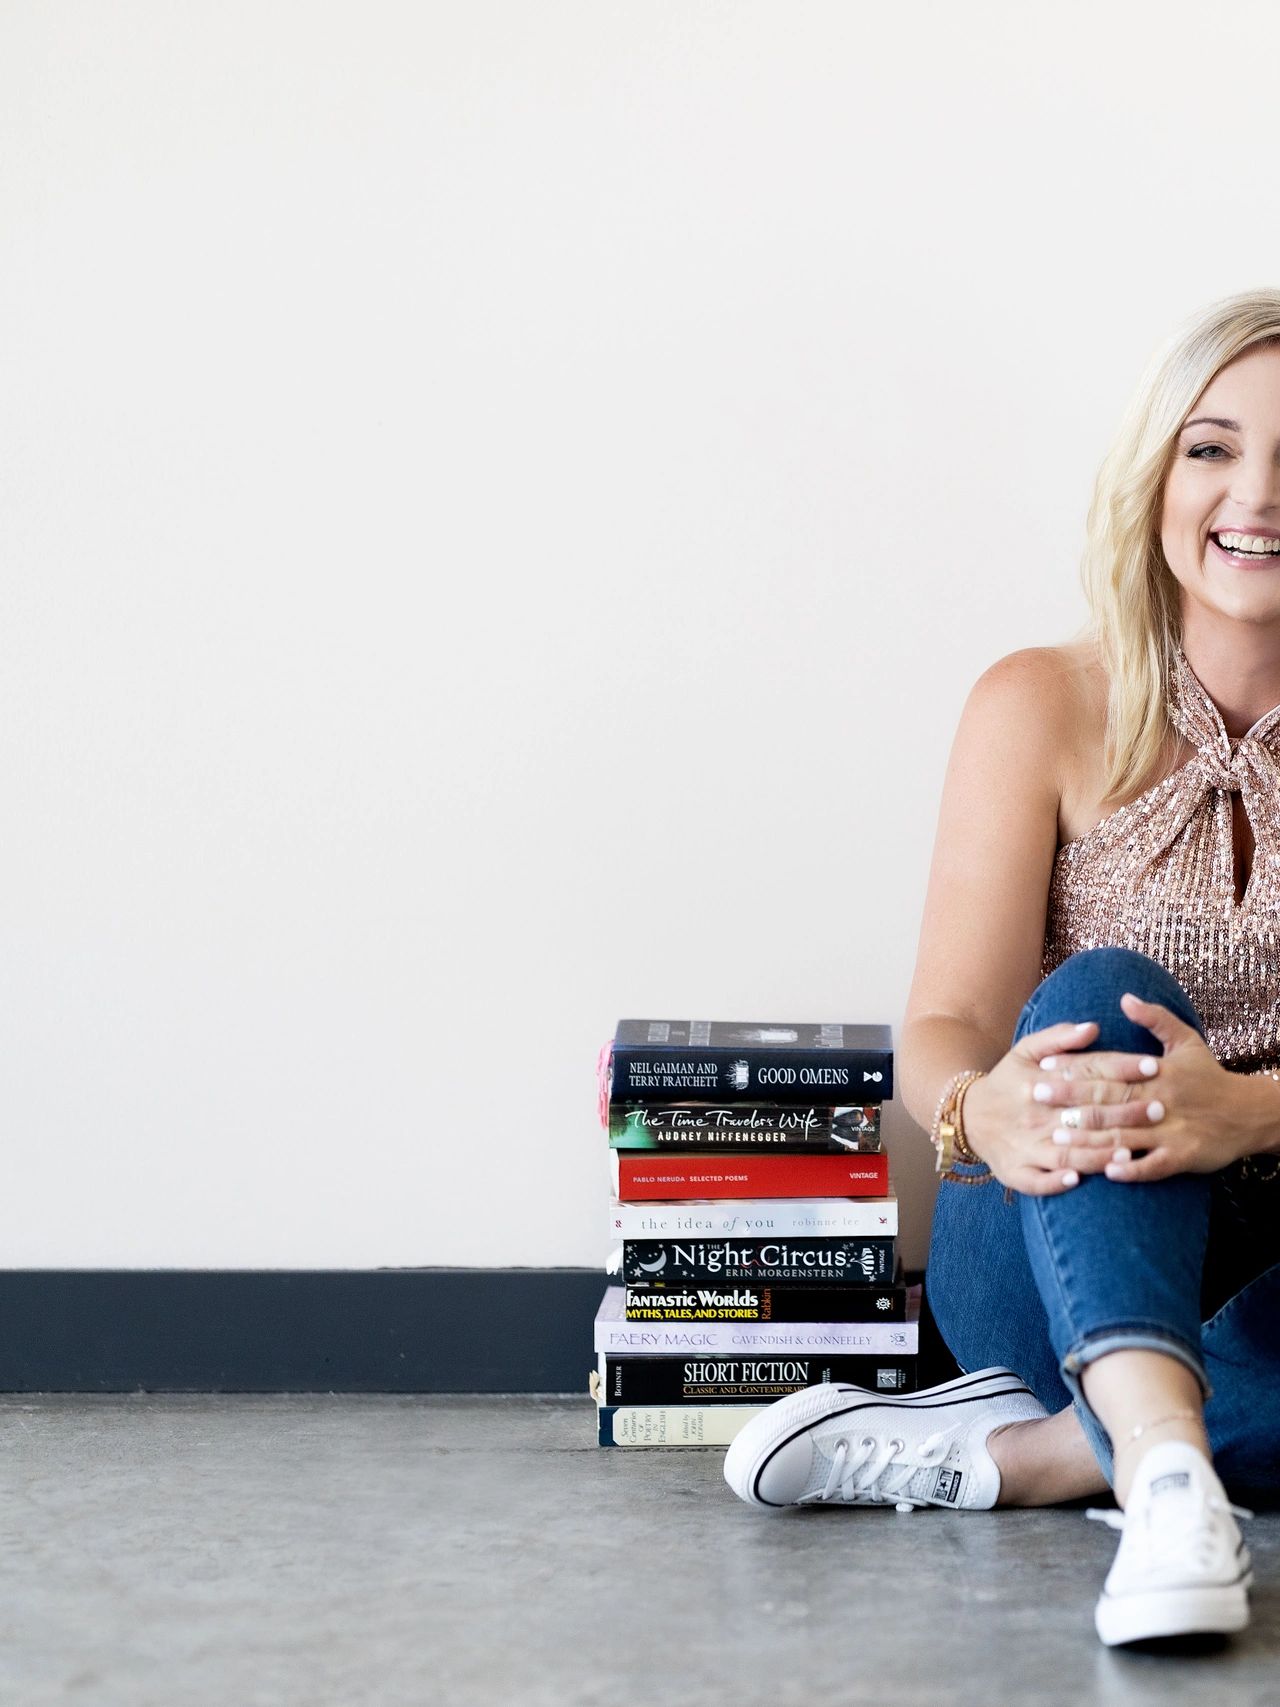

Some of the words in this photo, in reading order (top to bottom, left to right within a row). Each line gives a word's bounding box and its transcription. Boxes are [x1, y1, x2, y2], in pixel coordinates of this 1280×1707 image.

[629, 1062, 651, 1074] NEIL
[653, 1063, 694, 1075] GAIMAN
[697, 1064, 718, 1075] AND
[629, 1075, 660, 1087] TERRY
[662, 1075, 718, 1088] PRATCHETT
[757, 1067, 797, 1085] GOOD
[800, 1068, 849, 1085] OMENS
[624, 1109, 665, 1128] The
[658, 1110, 709, 1128] Time
[778, 1107, 822, 1141] Wife
[657, 1131, 701, 1142] AUDREY
[708, 1131, 787, 1143] NIFFENEGGER
[689, 1175, 723, 1183] SELECTED
[725, 1174, 749, 1182] POEMS
[849, 1171, 879, 1180] VINTAGE
[641, 1217, 668, 1230] the
[677, 1216, 713, 1230] idea
[722, 1216, 743, 1231] of
[745, 1218, 775, 1231] you
[792, 1216, 838, 1227] robinne
[842, 1215, 860, 1226] lee
[672, 1242, 753, 1272] Night
[760, 1243, 847, 1266] Circus
[725, 1268, 753, 1277] ERIN
[757, 1267, 845, 1278] MORGENSTERN
[761, 1288, 772, 1320] Rabkin
[626, 1308, 664, 1320] MYTHS,
[717, 1308, 758, 1319] STORIES
[610, 1333, 661, 1346] FAERY
[664, 1333, 720, 1346] MAGIC
[732, 1335, 793, 1346] CAVENDISH
[795, 1335, 804, 1346] &
[807, 1335, 872, 1346] CONNEELEY
[684, 1362, 739, 1383] SHORT
[742, 1361, 810, 1382] FICTION
